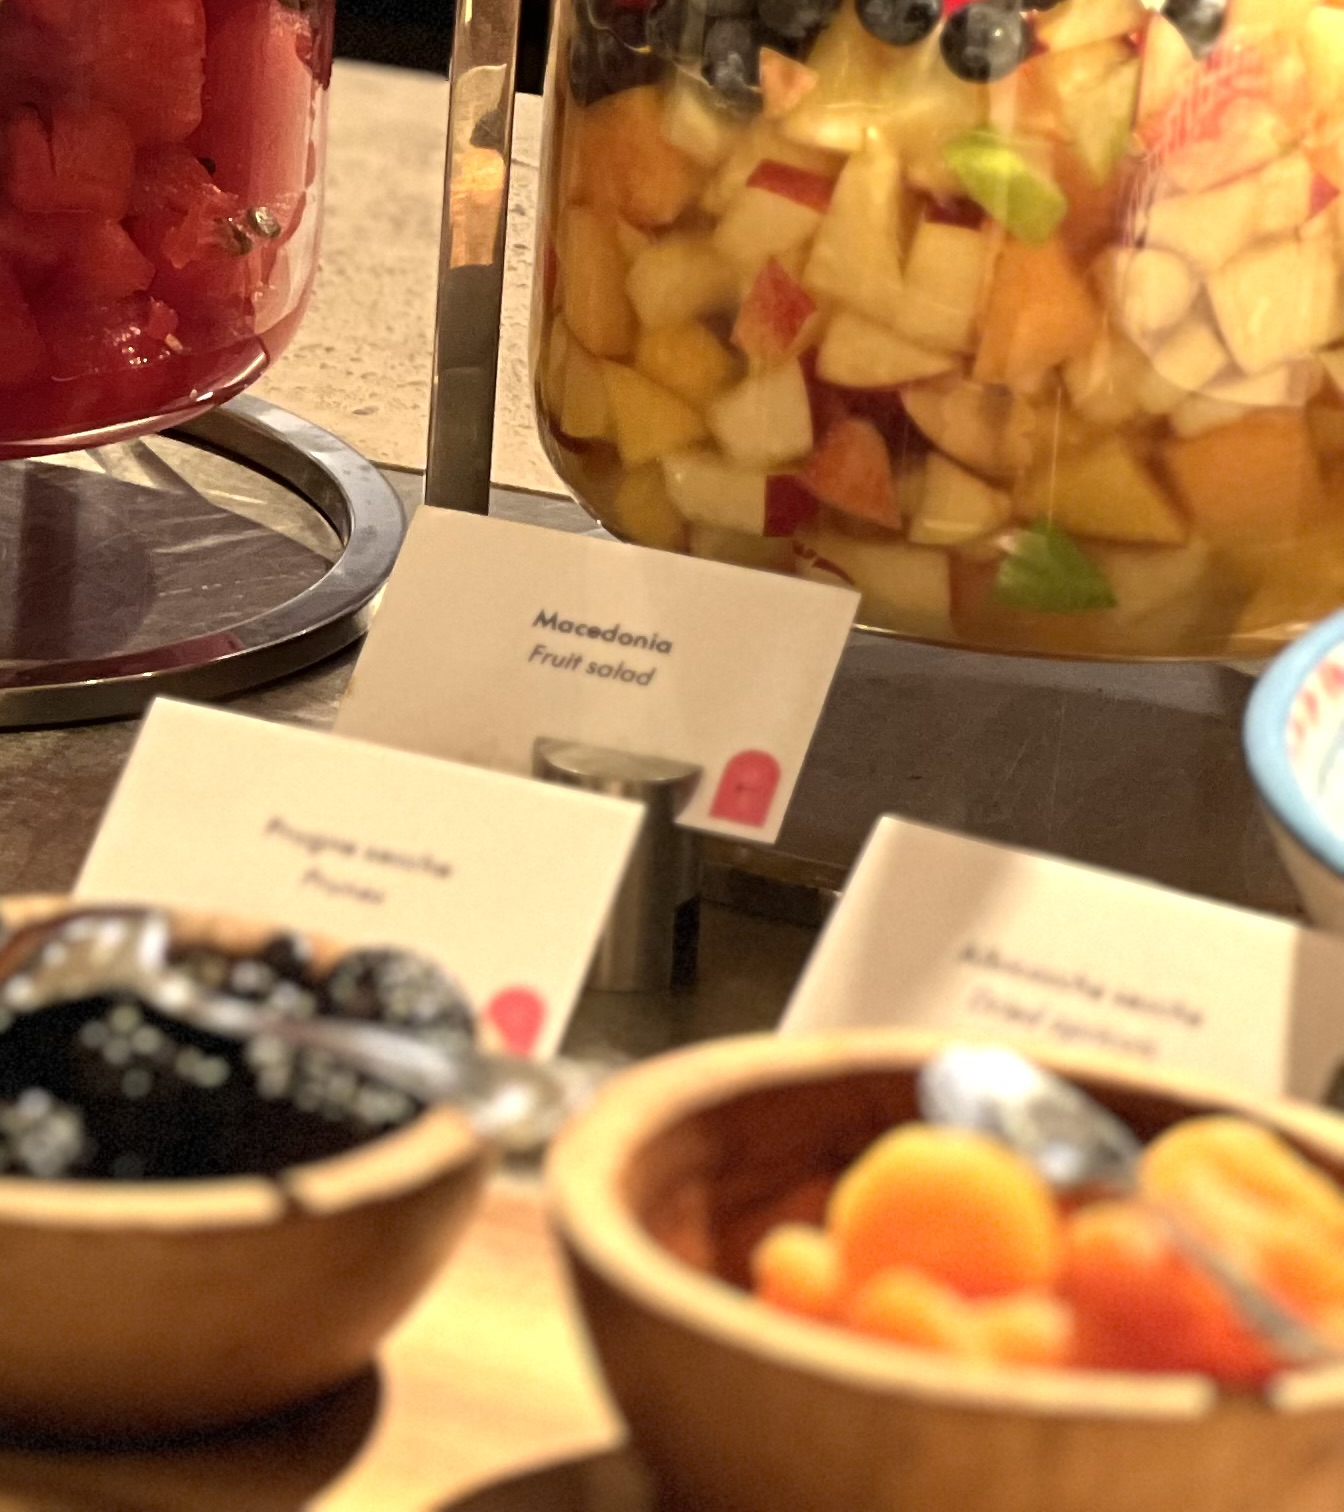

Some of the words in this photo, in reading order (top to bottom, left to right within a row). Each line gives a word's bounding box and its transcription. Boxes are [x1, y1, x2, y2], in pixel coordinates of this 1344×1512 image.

[532, 608, 673, 654] Macedonia
[527, 644, 584, 671] Fruit
[585, 661, 657, 686] salad
